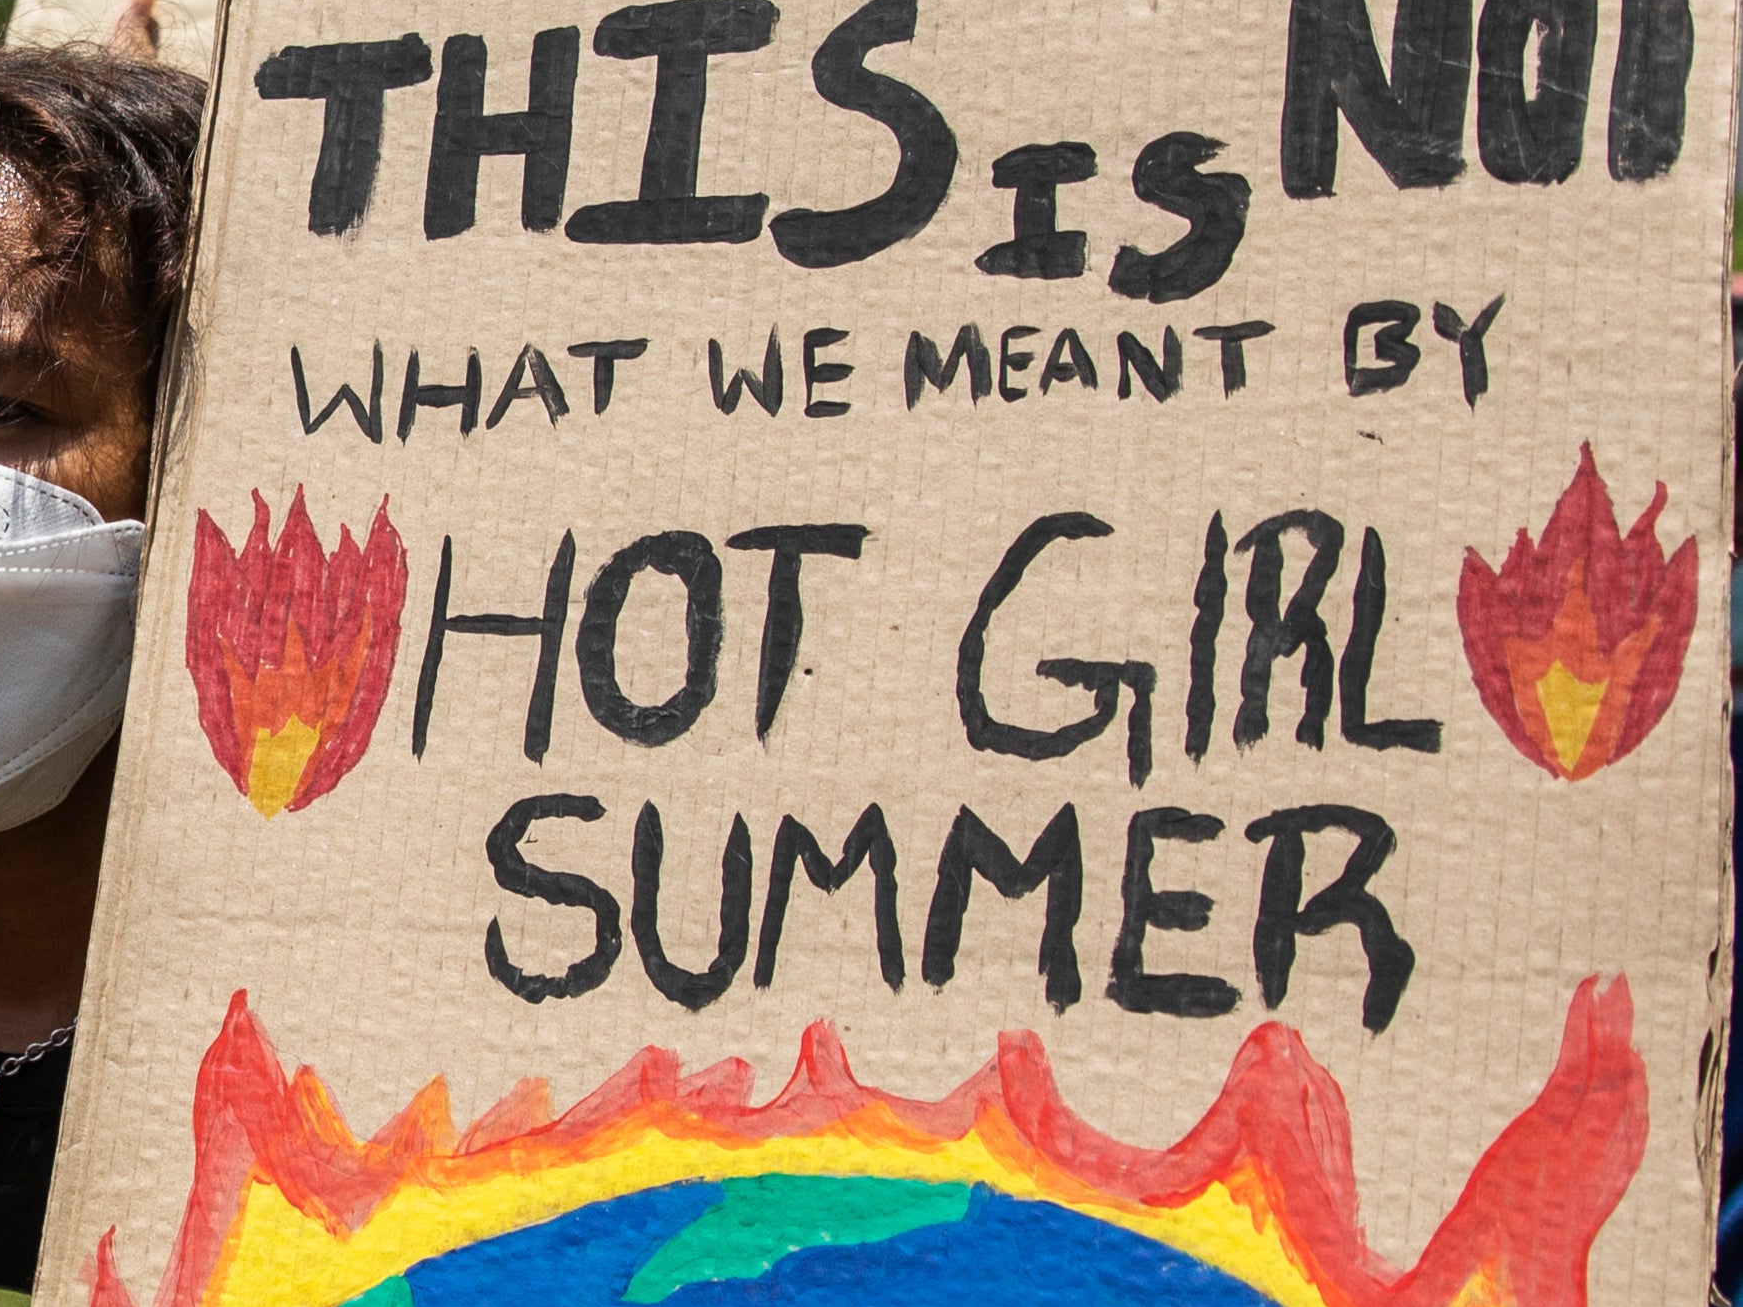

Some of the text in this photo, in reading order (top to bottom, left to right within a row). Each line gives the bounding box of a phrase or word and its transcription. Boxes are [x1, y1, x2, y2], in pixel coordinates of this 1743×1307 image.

[975, 131, 1252, 303] IS
[290, 294, 1505, 445] WHAT WE MEANT BY
[413, 508, 1443, 787] HOT GIRL
[484, 793, 1415, 1035] SUMMER
